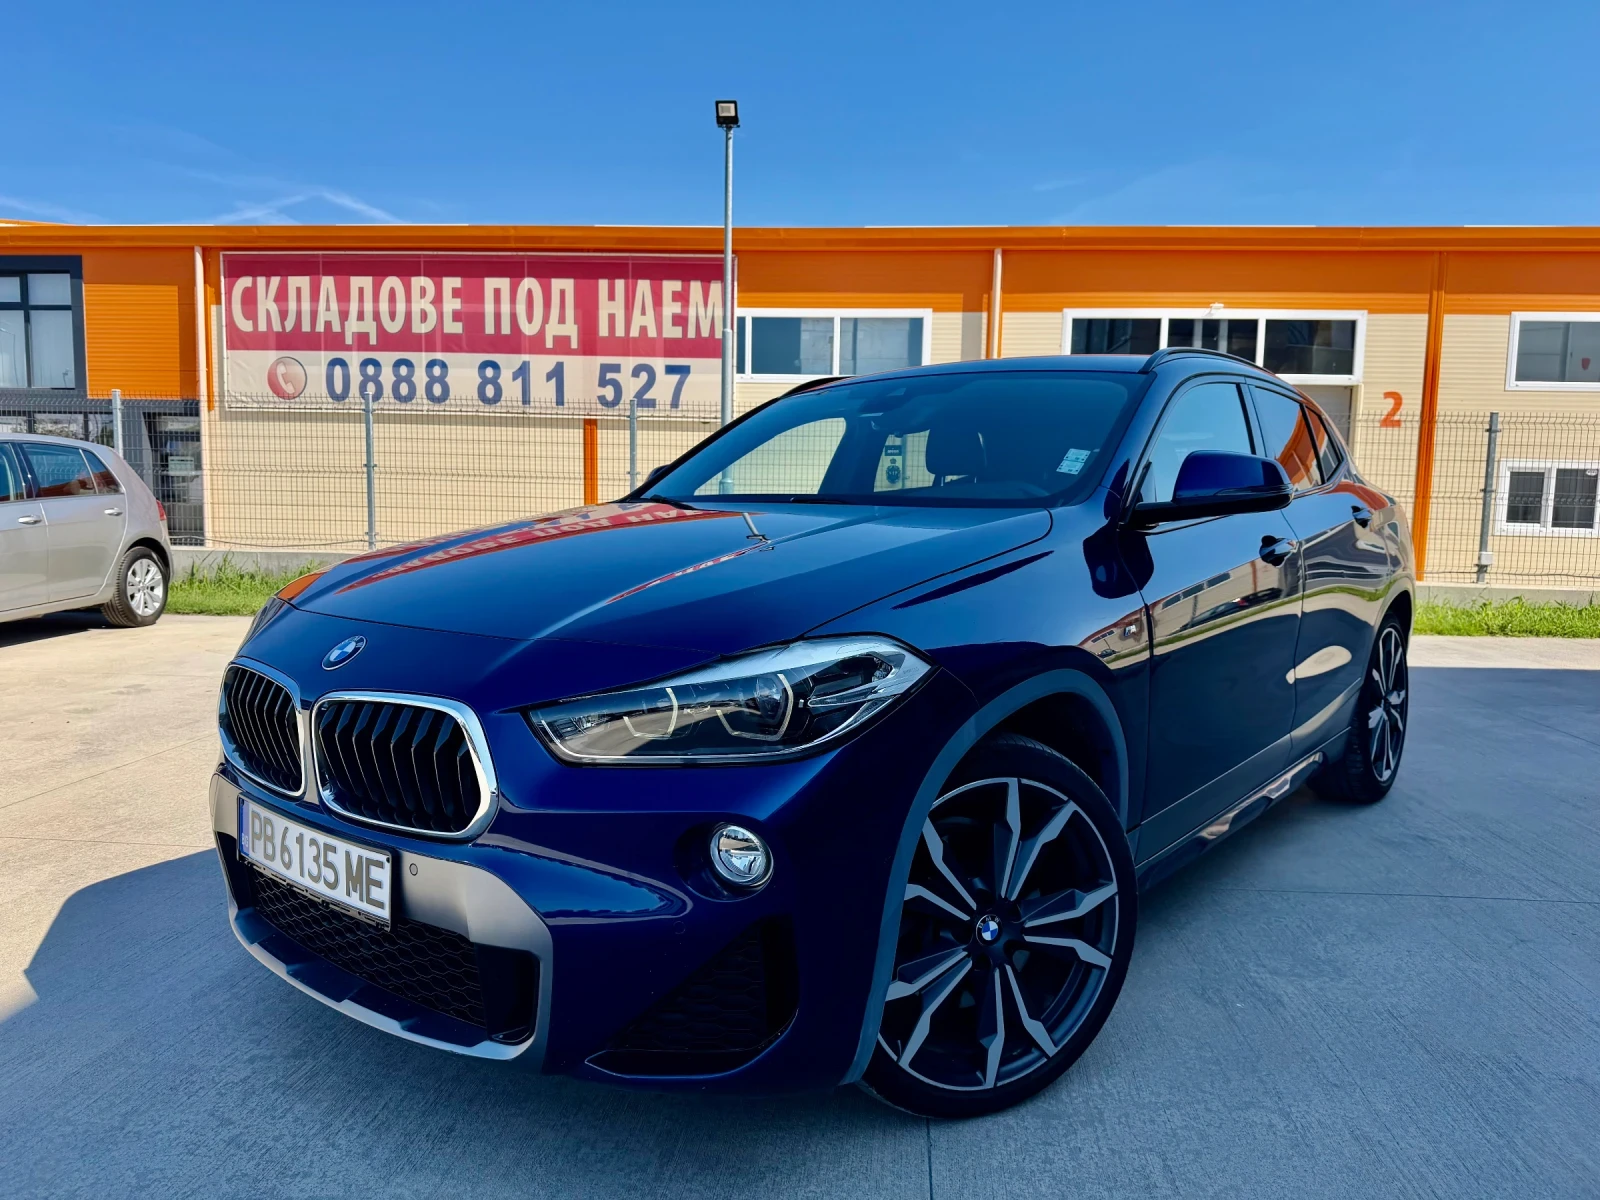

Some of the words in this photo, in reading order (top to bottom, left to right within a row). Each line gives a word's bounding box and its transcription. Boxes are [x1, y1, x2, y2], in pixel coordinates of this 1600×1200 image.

[231, 275, 464, 346] СКЛАДОВЕ
[483, 276, 579, 349] ПОД
[597, 278, 725, 340] НАЕМ
[325, 357, 451, 404] 0888
[476, 359, 566, 407] 811
[596, 362, 692, 410] 527
[1379, 391, 1404, 429] 2
